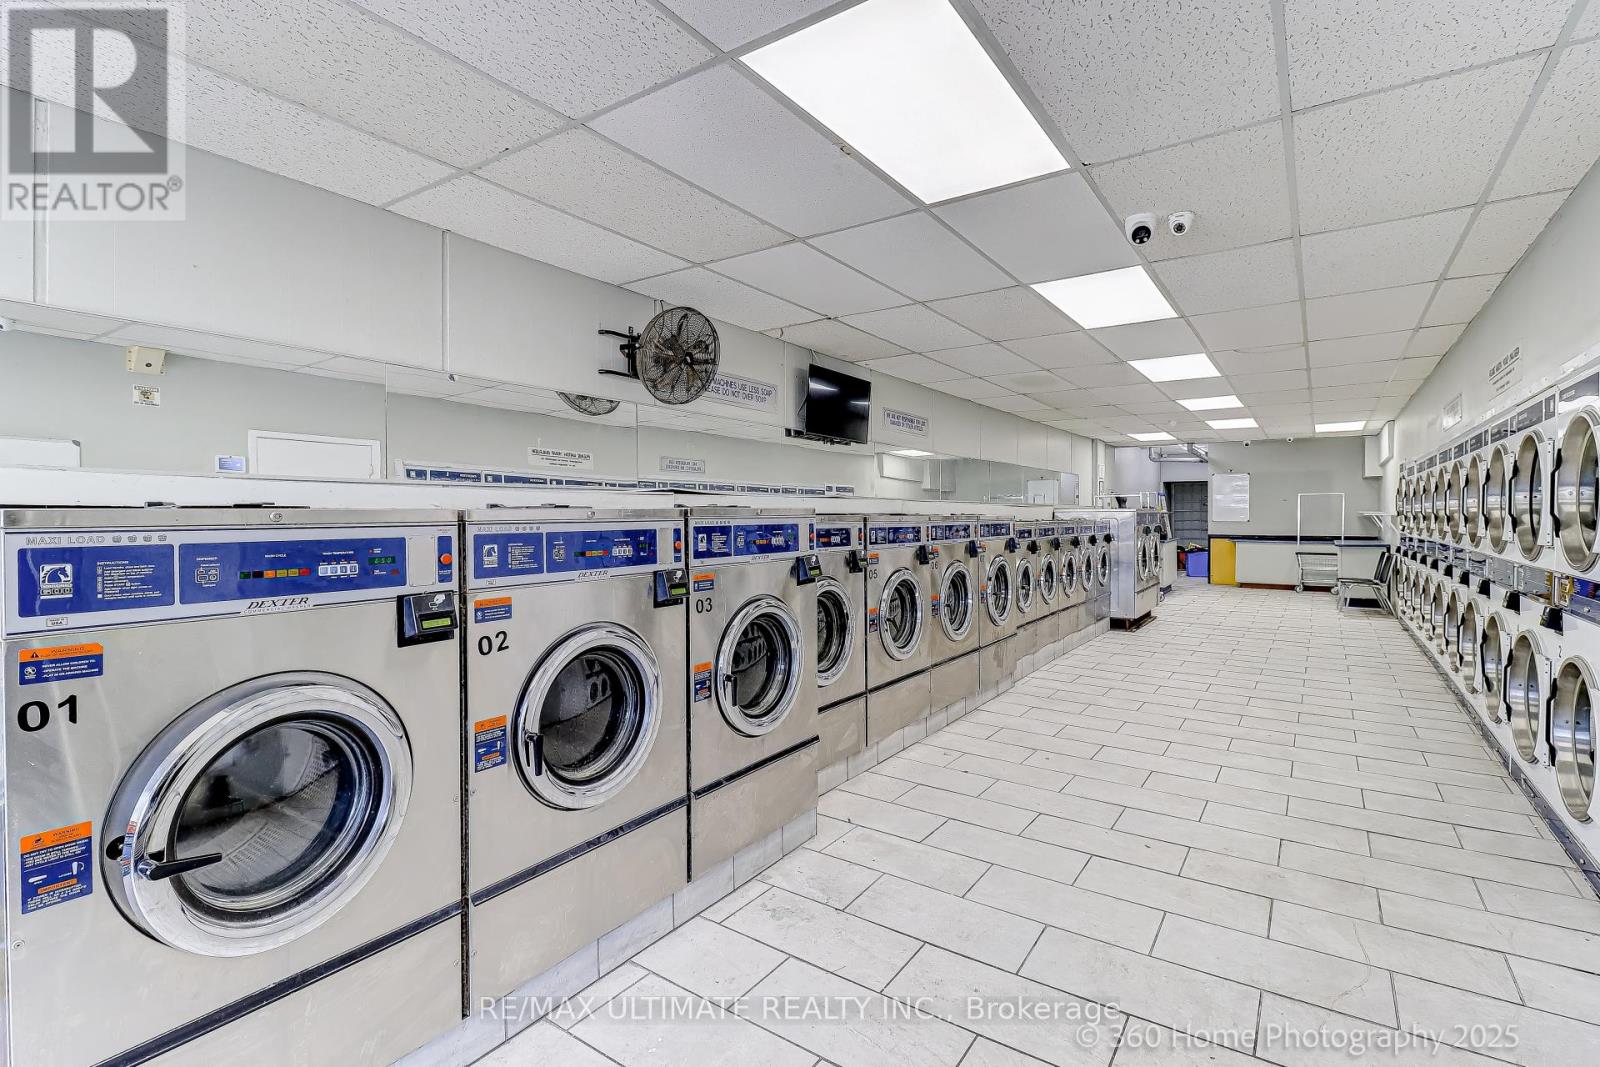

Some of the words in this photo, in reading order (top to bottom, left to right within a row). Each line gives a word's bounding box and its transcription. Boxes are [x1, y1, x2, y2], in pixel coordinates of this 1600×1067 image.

[749, 385, 759, 394] LESS
[761, 388, 772, 397] SOAP
[26, 536, 62, 546] MAXI
[68, 536, 106, 544] LOAD
[869, 569, 878, 579] 05
[248, 597, 309, 609] DEXTER
[696, 598, 712, 613] 03
[478, 631, 509, 655] 02
[17, 694, 77, 732] 01
